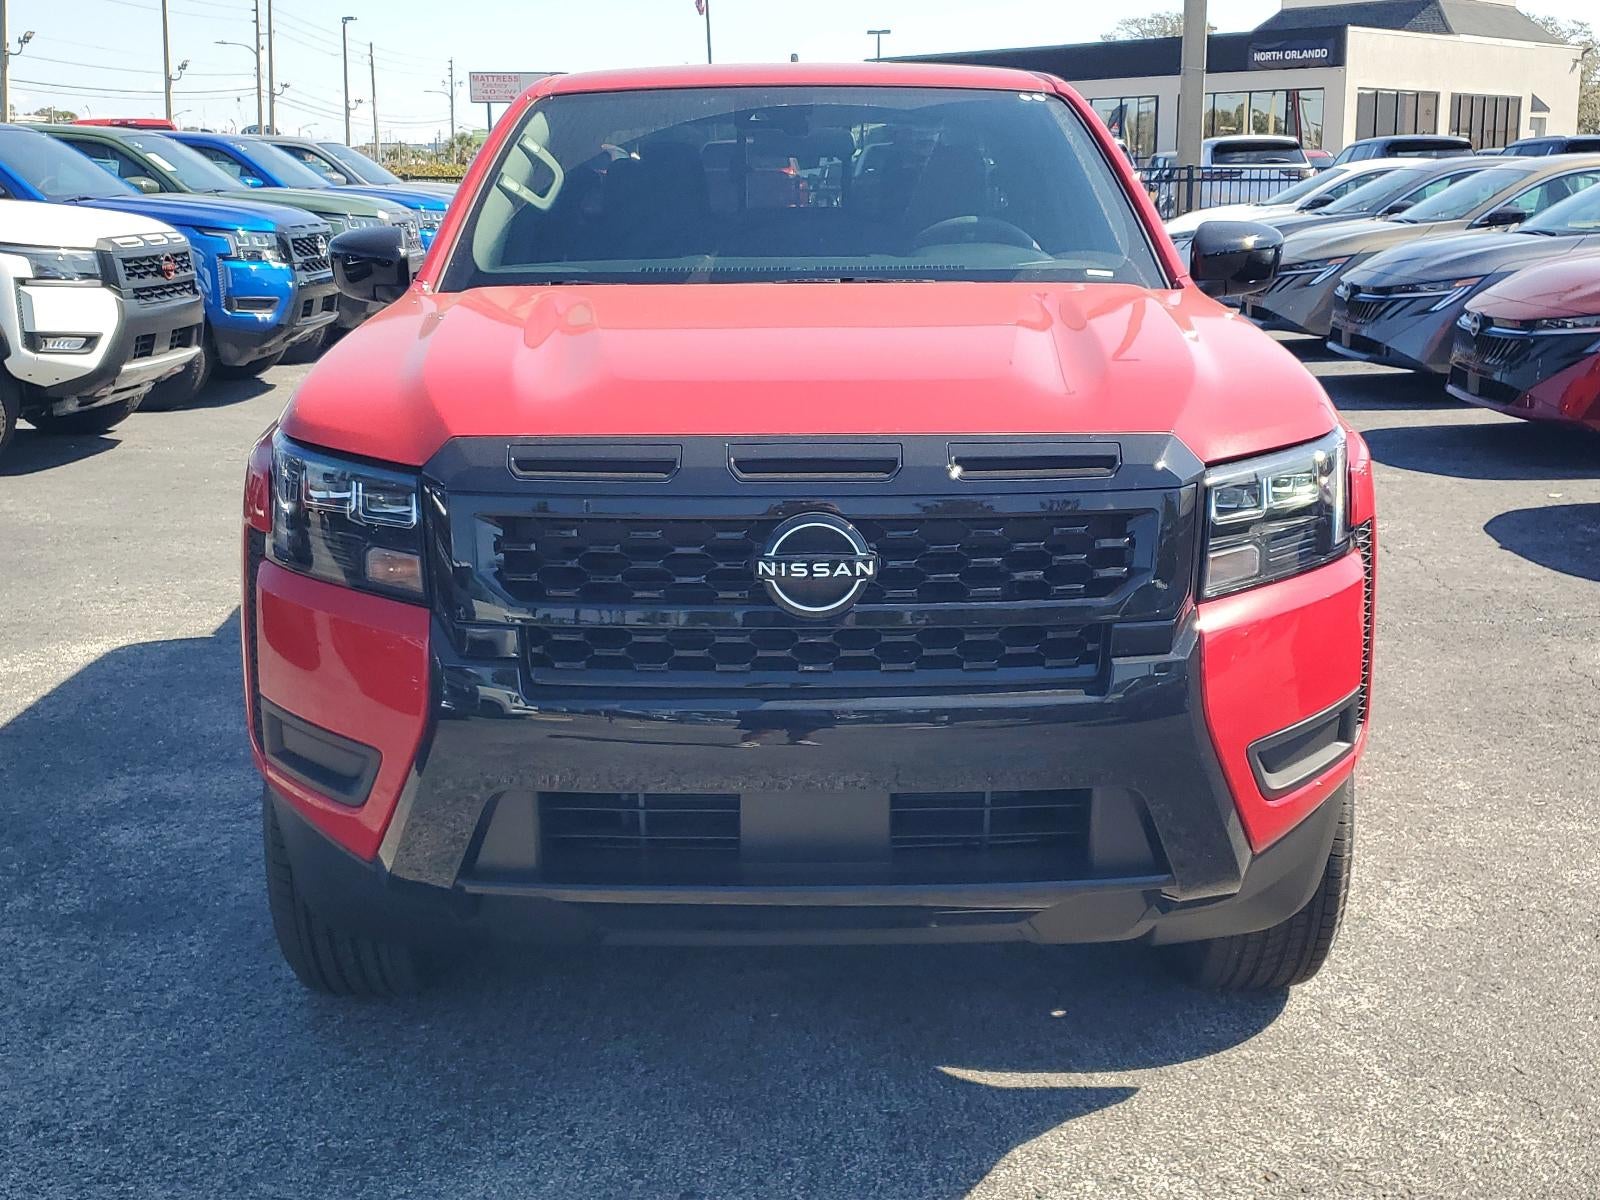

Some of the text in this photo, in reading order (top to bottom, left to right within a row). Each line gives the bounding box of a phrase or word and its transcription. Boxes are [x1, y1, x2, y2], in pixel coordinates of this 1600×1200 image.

[1253, 48, 1328, 61] NORTH ORLANDO
[472, 75, 519, 83] MATTRESS
[758, 560, 874, 577] NISSAN
